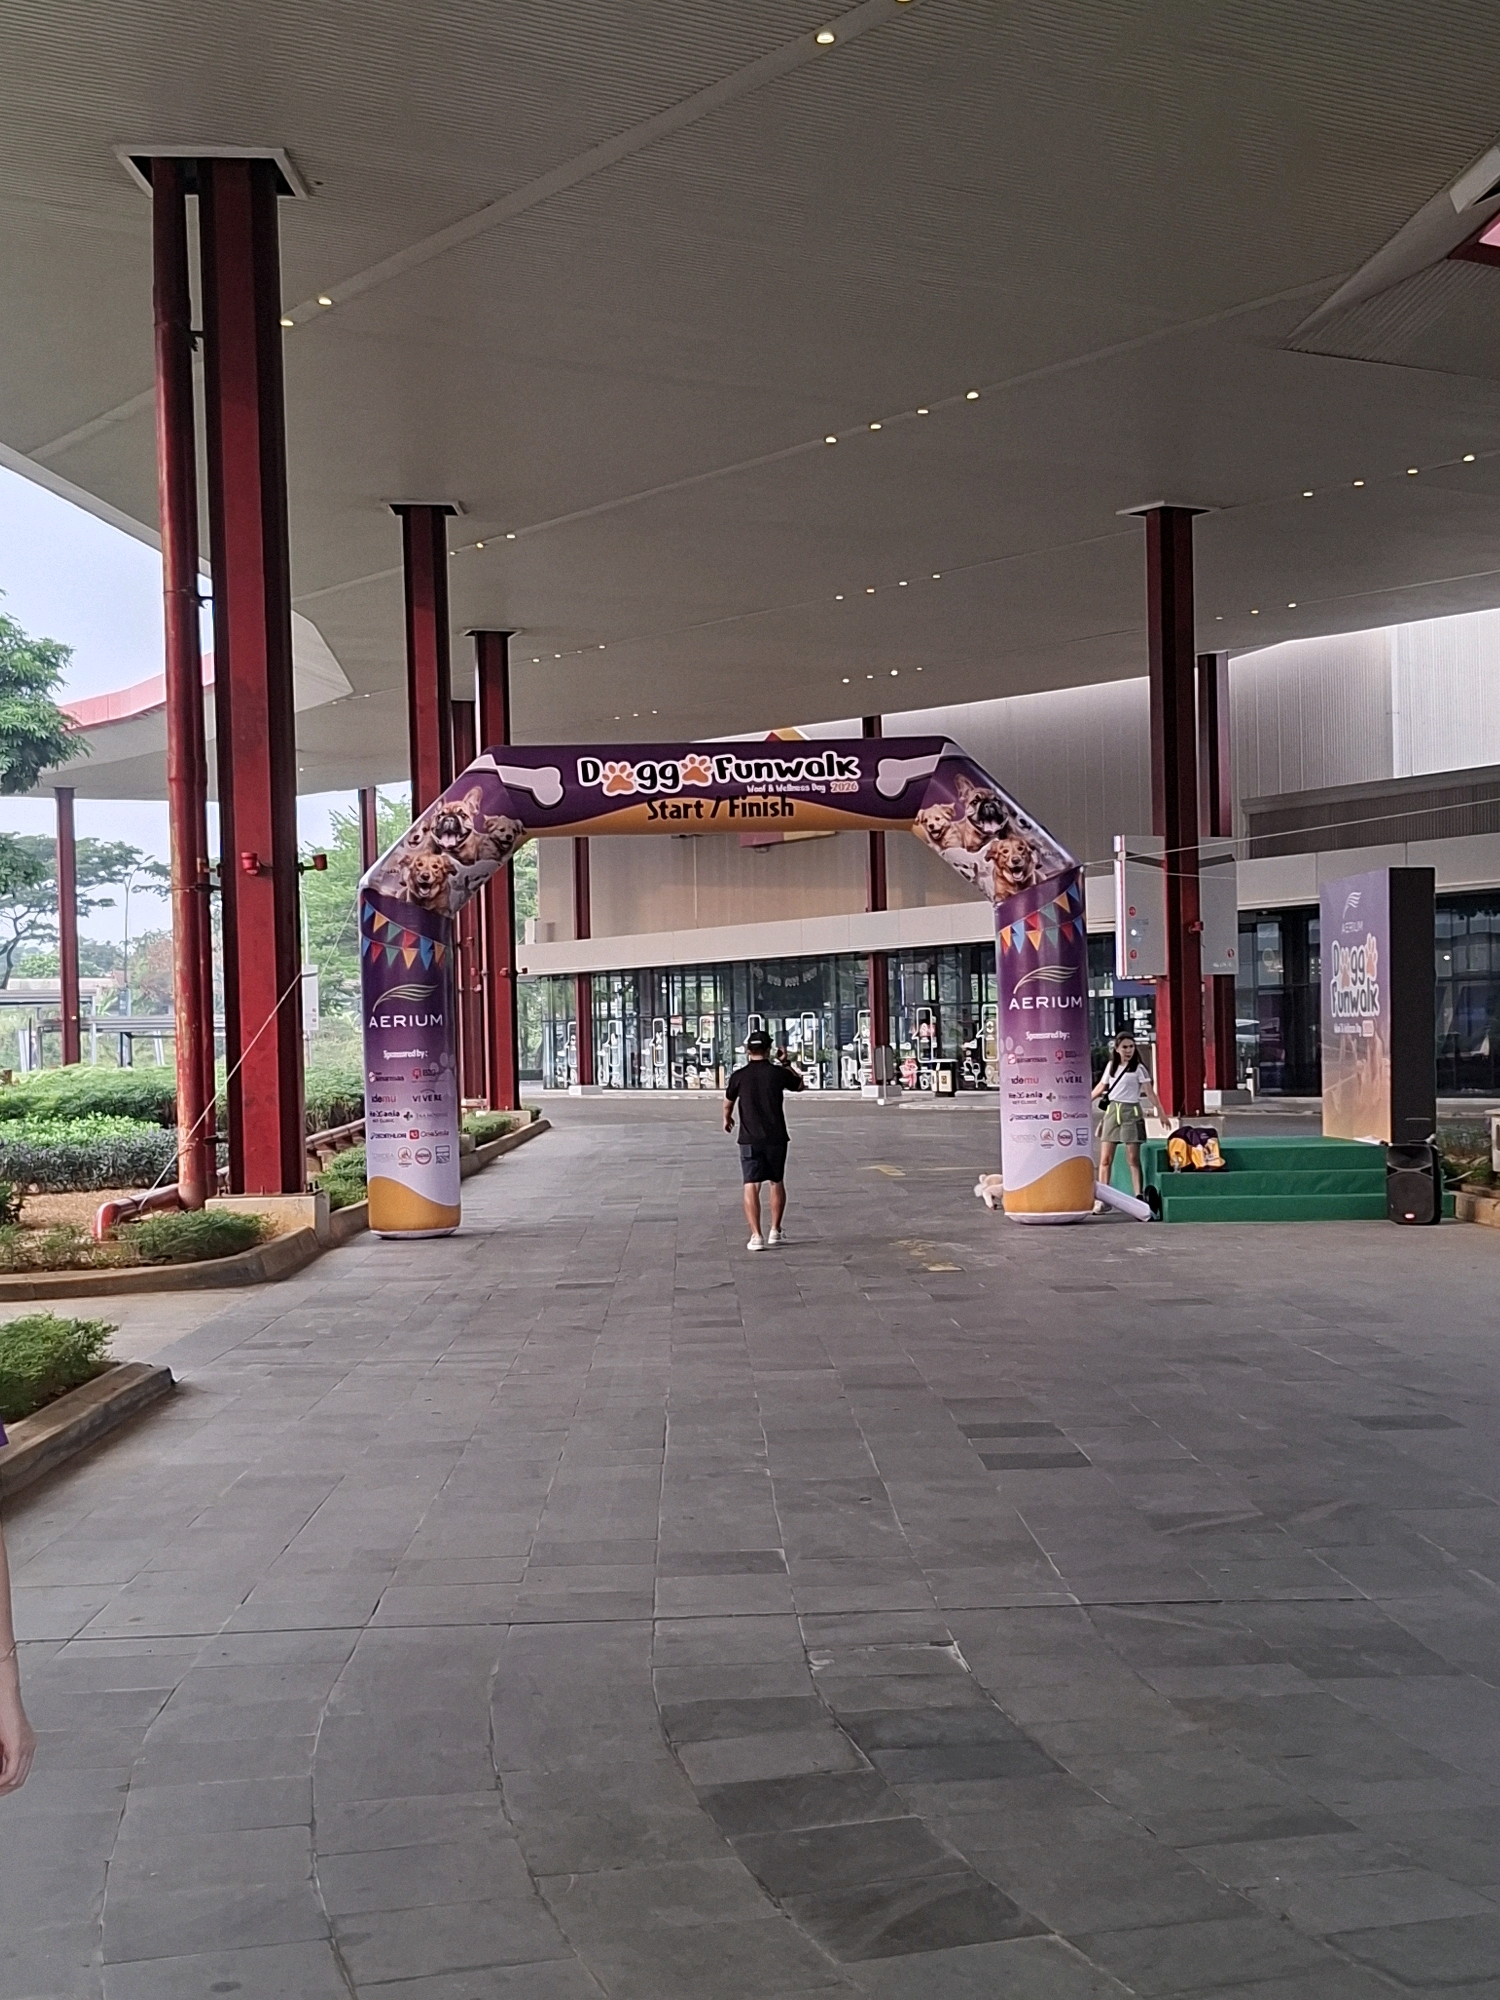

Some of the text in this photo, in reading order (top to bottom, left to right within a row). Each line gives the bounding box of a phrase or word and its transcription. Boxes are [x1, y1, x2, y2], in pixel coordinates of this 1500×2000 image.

[578, 752, 860, 796] Dgg Funwalk
[747, 781, 859, 793] Woof & Wellness Day 2026
[647, 795, 794, 820] Start / Finish
[1009, 995, 1083, 1011] AERIUM
[1331, 977, 1378, 1015] Funwalk
[368, 1013, 443, 1029] AERIUM
